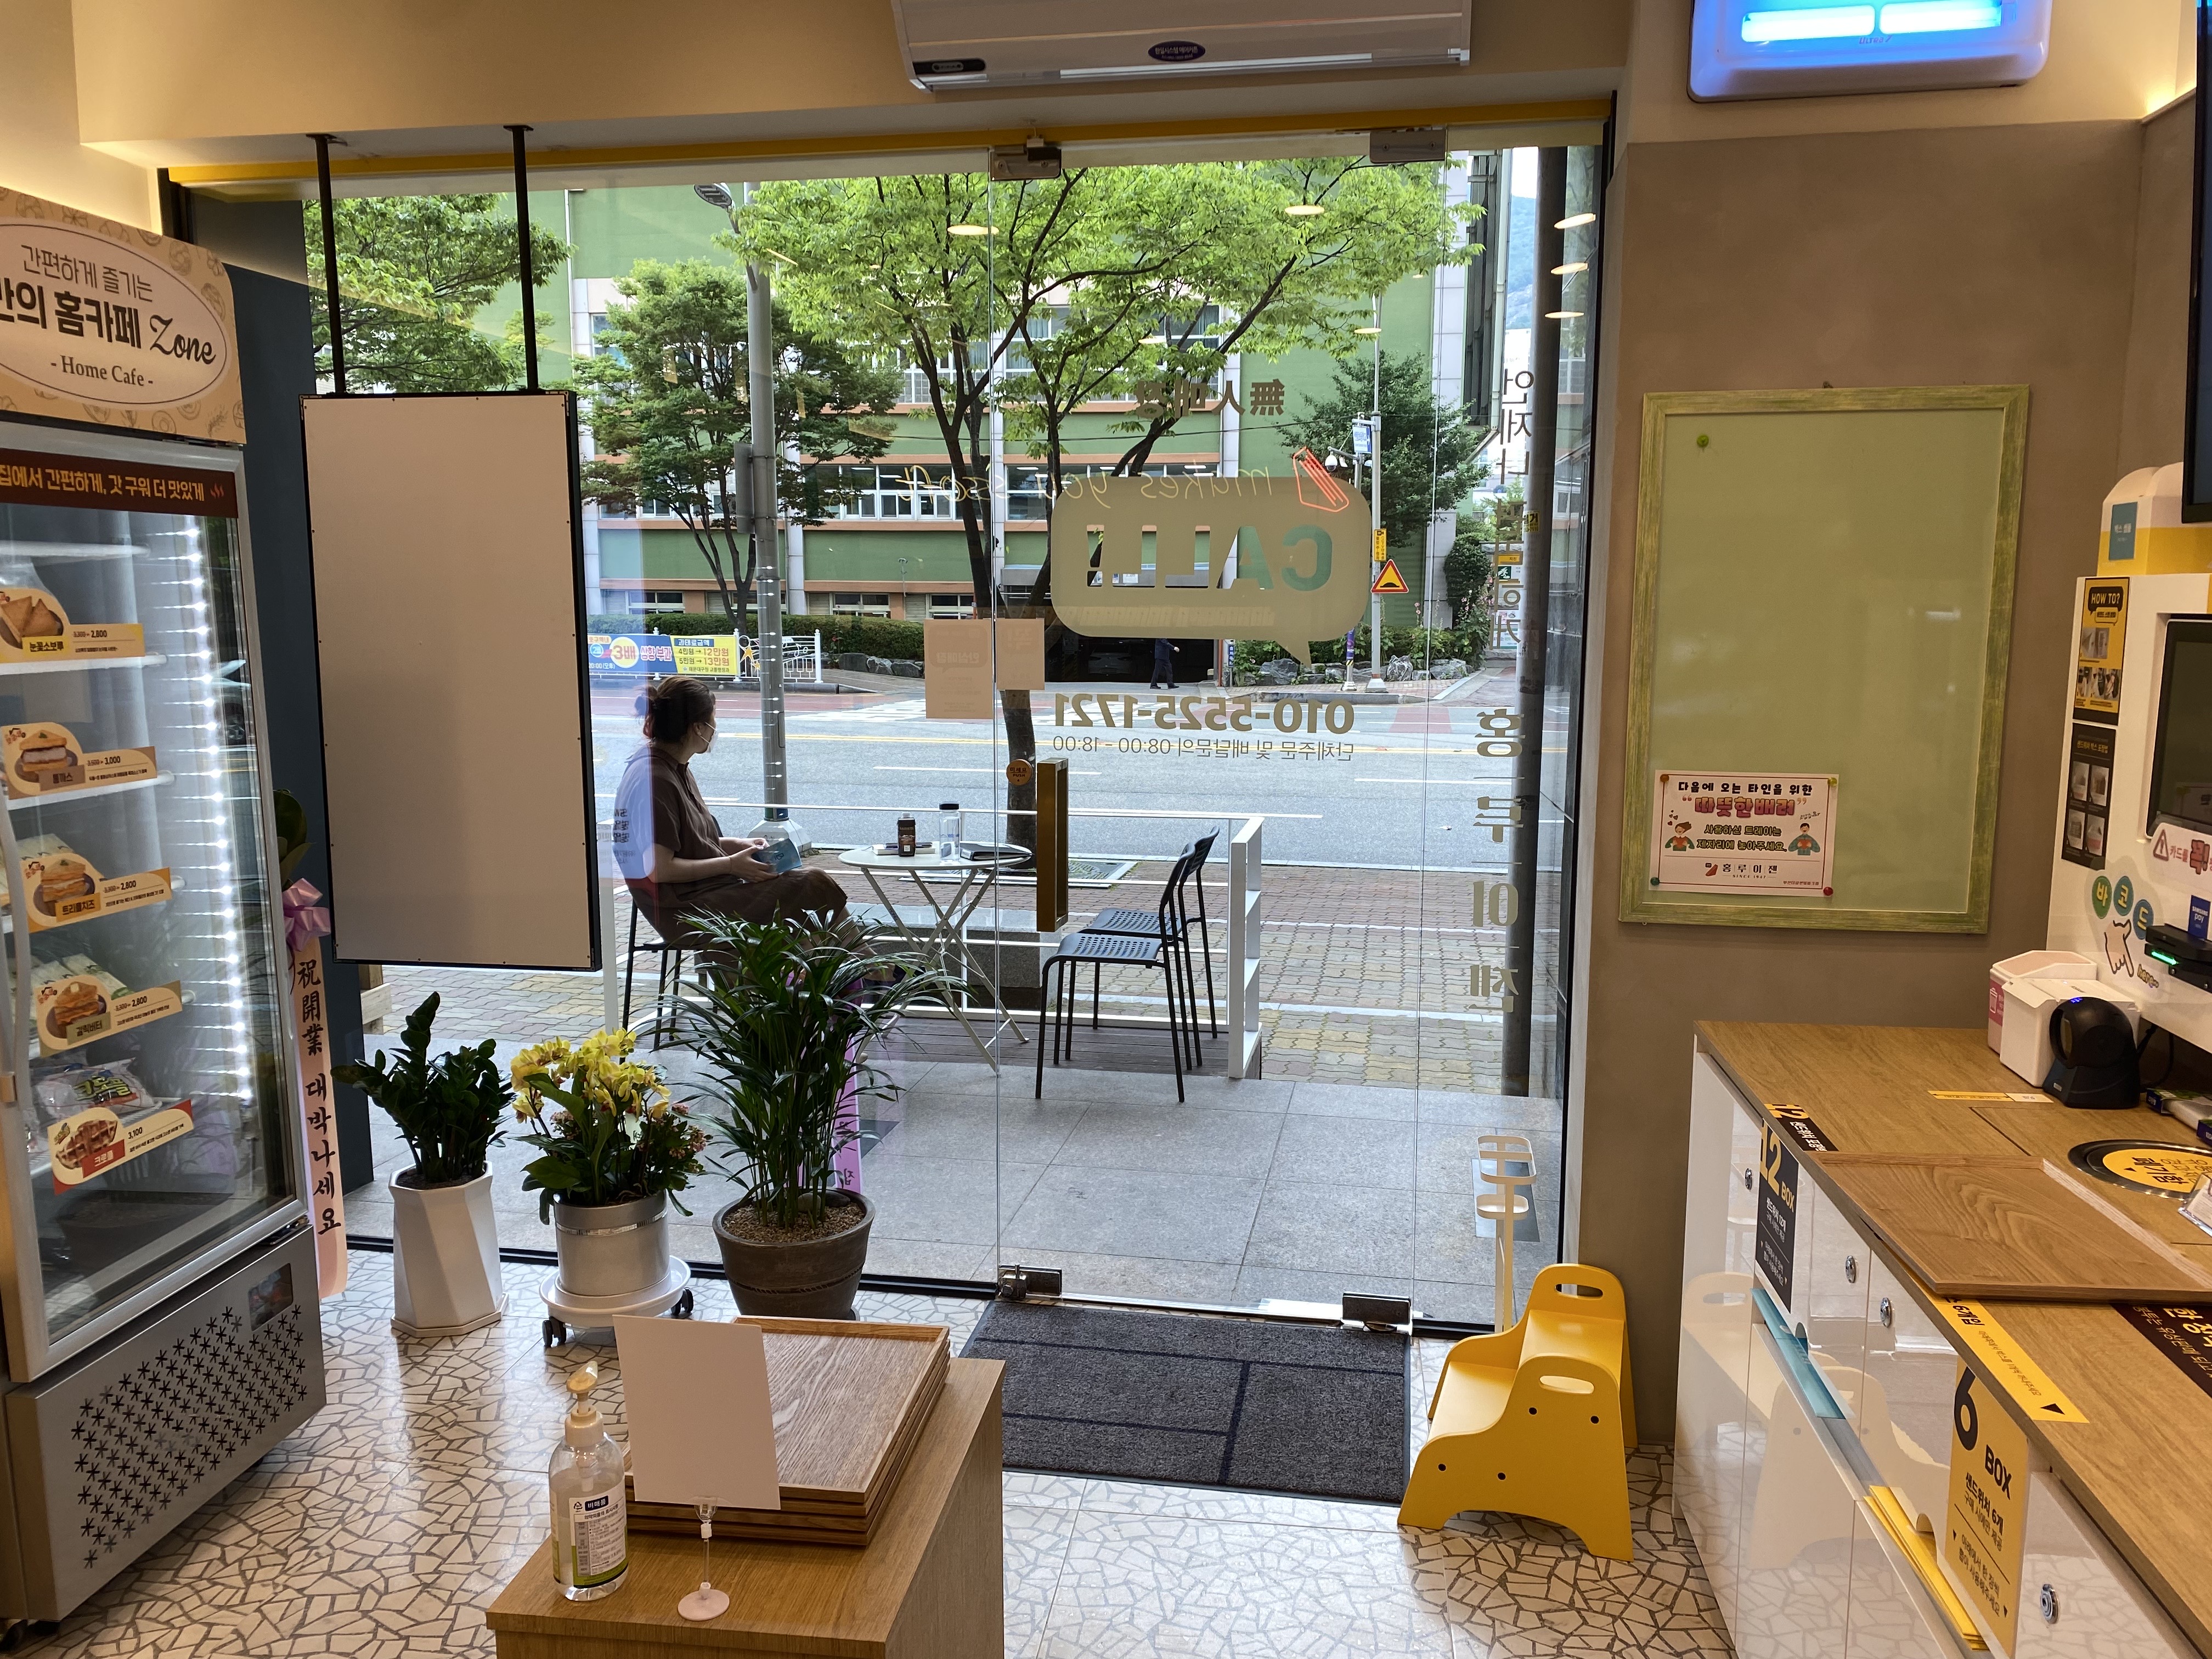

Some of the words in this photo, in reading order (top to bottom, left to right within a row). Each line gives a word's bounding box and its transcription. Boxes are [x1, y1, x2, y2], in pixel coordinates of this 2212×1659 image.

[21, 245, 97, 289] 간편하게
[102, 266, 153, 302] 즐기는
[54, 291, 141, 348] 홈카페
[149, 314, 216, 365] Zone
[60, 354, 107, 380] Home
[111, 365, 145, 387] Cafe
[0, 465, 43, 488] 집에서
[45, 469, 107, 494] 간편하게,
[109, 475, 122, 494] 갓
[125, 477, 151, 497] 구워
[153, 479, 166, 498] 더
[168, 481, 205, 501] 맛있게
[2091, 593, 2107, 604] HOW
[2108, 593, 2120, 604] TO?
[613, 645, 636, 660] 3배
[703, 648, 729, 657] 12만원
[704, 657, 730, 666] 13만원
[1678, 781, 1714, 792] 다음에
[1720, 782, 1741, 794] 오는
[1748, 783, 1782, 795] 타인을
[1789, 784, 1813, 795] 위한
[1703, 824, 1742, 836] 사용하신
[1744, 825, 1782, 837] 트레이는
[1696, 839, 1735, 850] 제자리에
[2194, 913, 2205, 923] pay
[128, 1126, 143, 1139] 3,100
[305, 1073, 342, 1236] 대박나세요
[2131, 1157, 2190, 1184] 폐기함
[1781, 1181, 1795, 1213] BOX
[1953, 1305, 1985, 1325] 6개입
[1954, 1366, 1979, 1451] 6
[1984, 1444, 2012, 1500] BOX
[1965, 1490, 1974, 1513] 구매
[1966, 1471, 1990, 1518] 샌드위치
[1991, 1508, 2004, 1536] 6개
